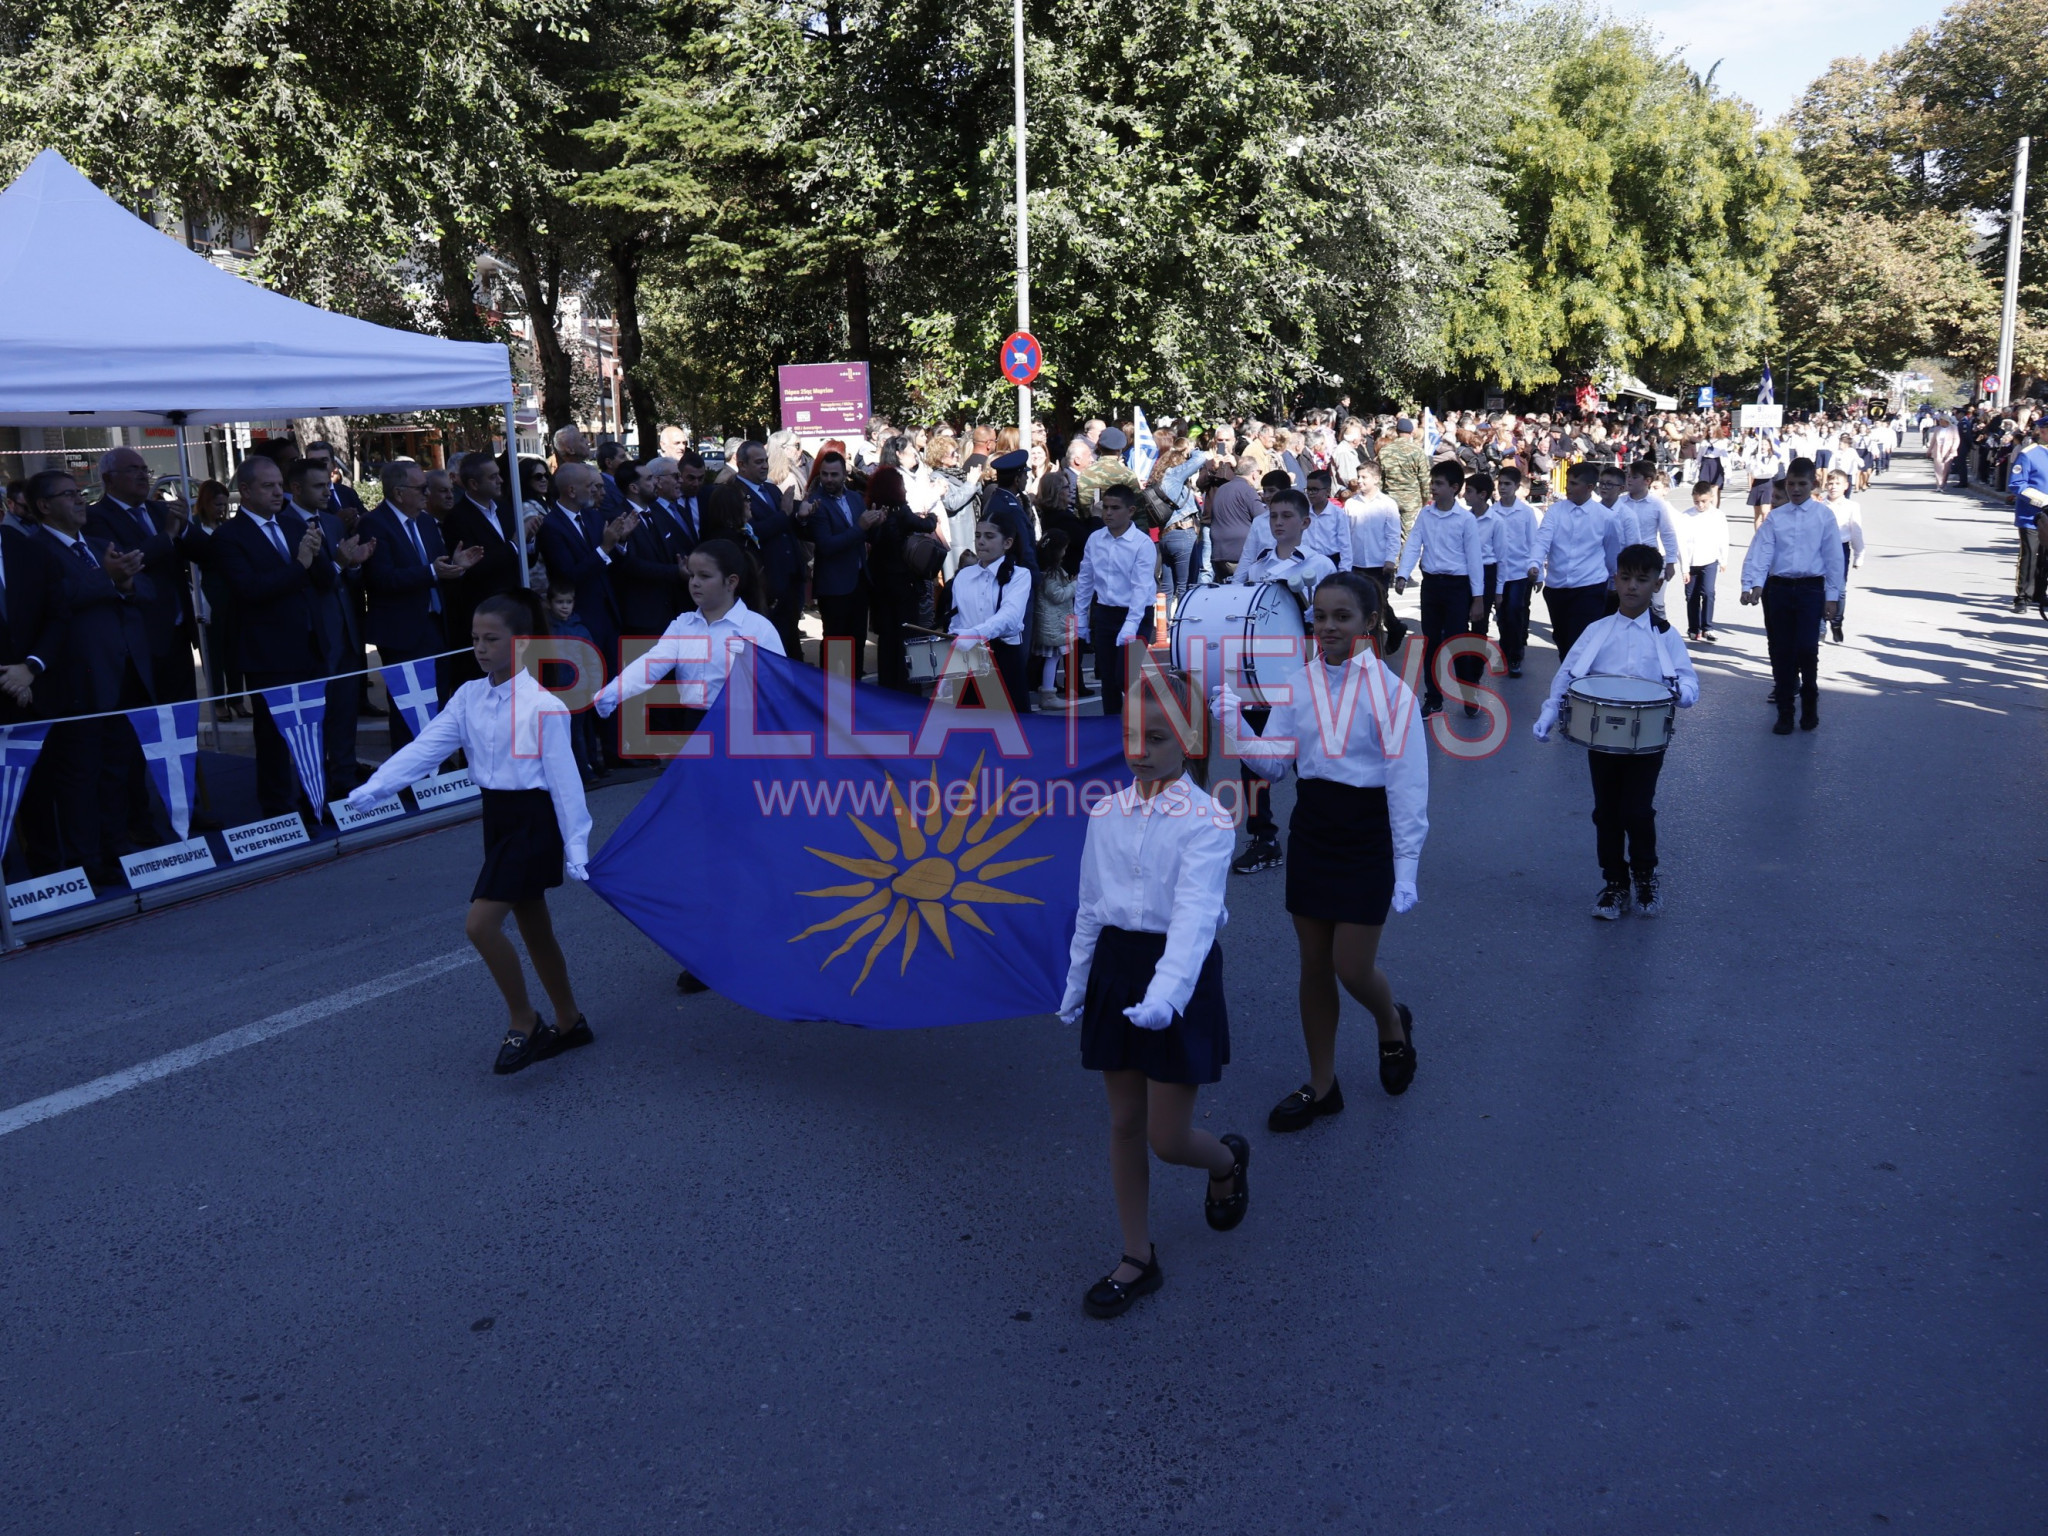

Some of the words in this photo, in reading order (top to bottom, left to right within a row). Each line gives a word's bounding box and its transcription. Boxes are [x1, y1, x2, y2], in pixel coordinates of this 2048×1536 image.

[349, 802, 401, 824] ΚΟΙΝΟΤΗΤΑΣ
[228, 817, 299, 842] ΕΚΠΡΟΣΩΠΟΣ
[234, 830, 304, 856] ΚΥΒΕΡΝΗΣΗΣ
[129, 847, 209, 878] ΑΝΤΙΠΕΡΙΦΕΡΕΙΑΡΧΗΣ
